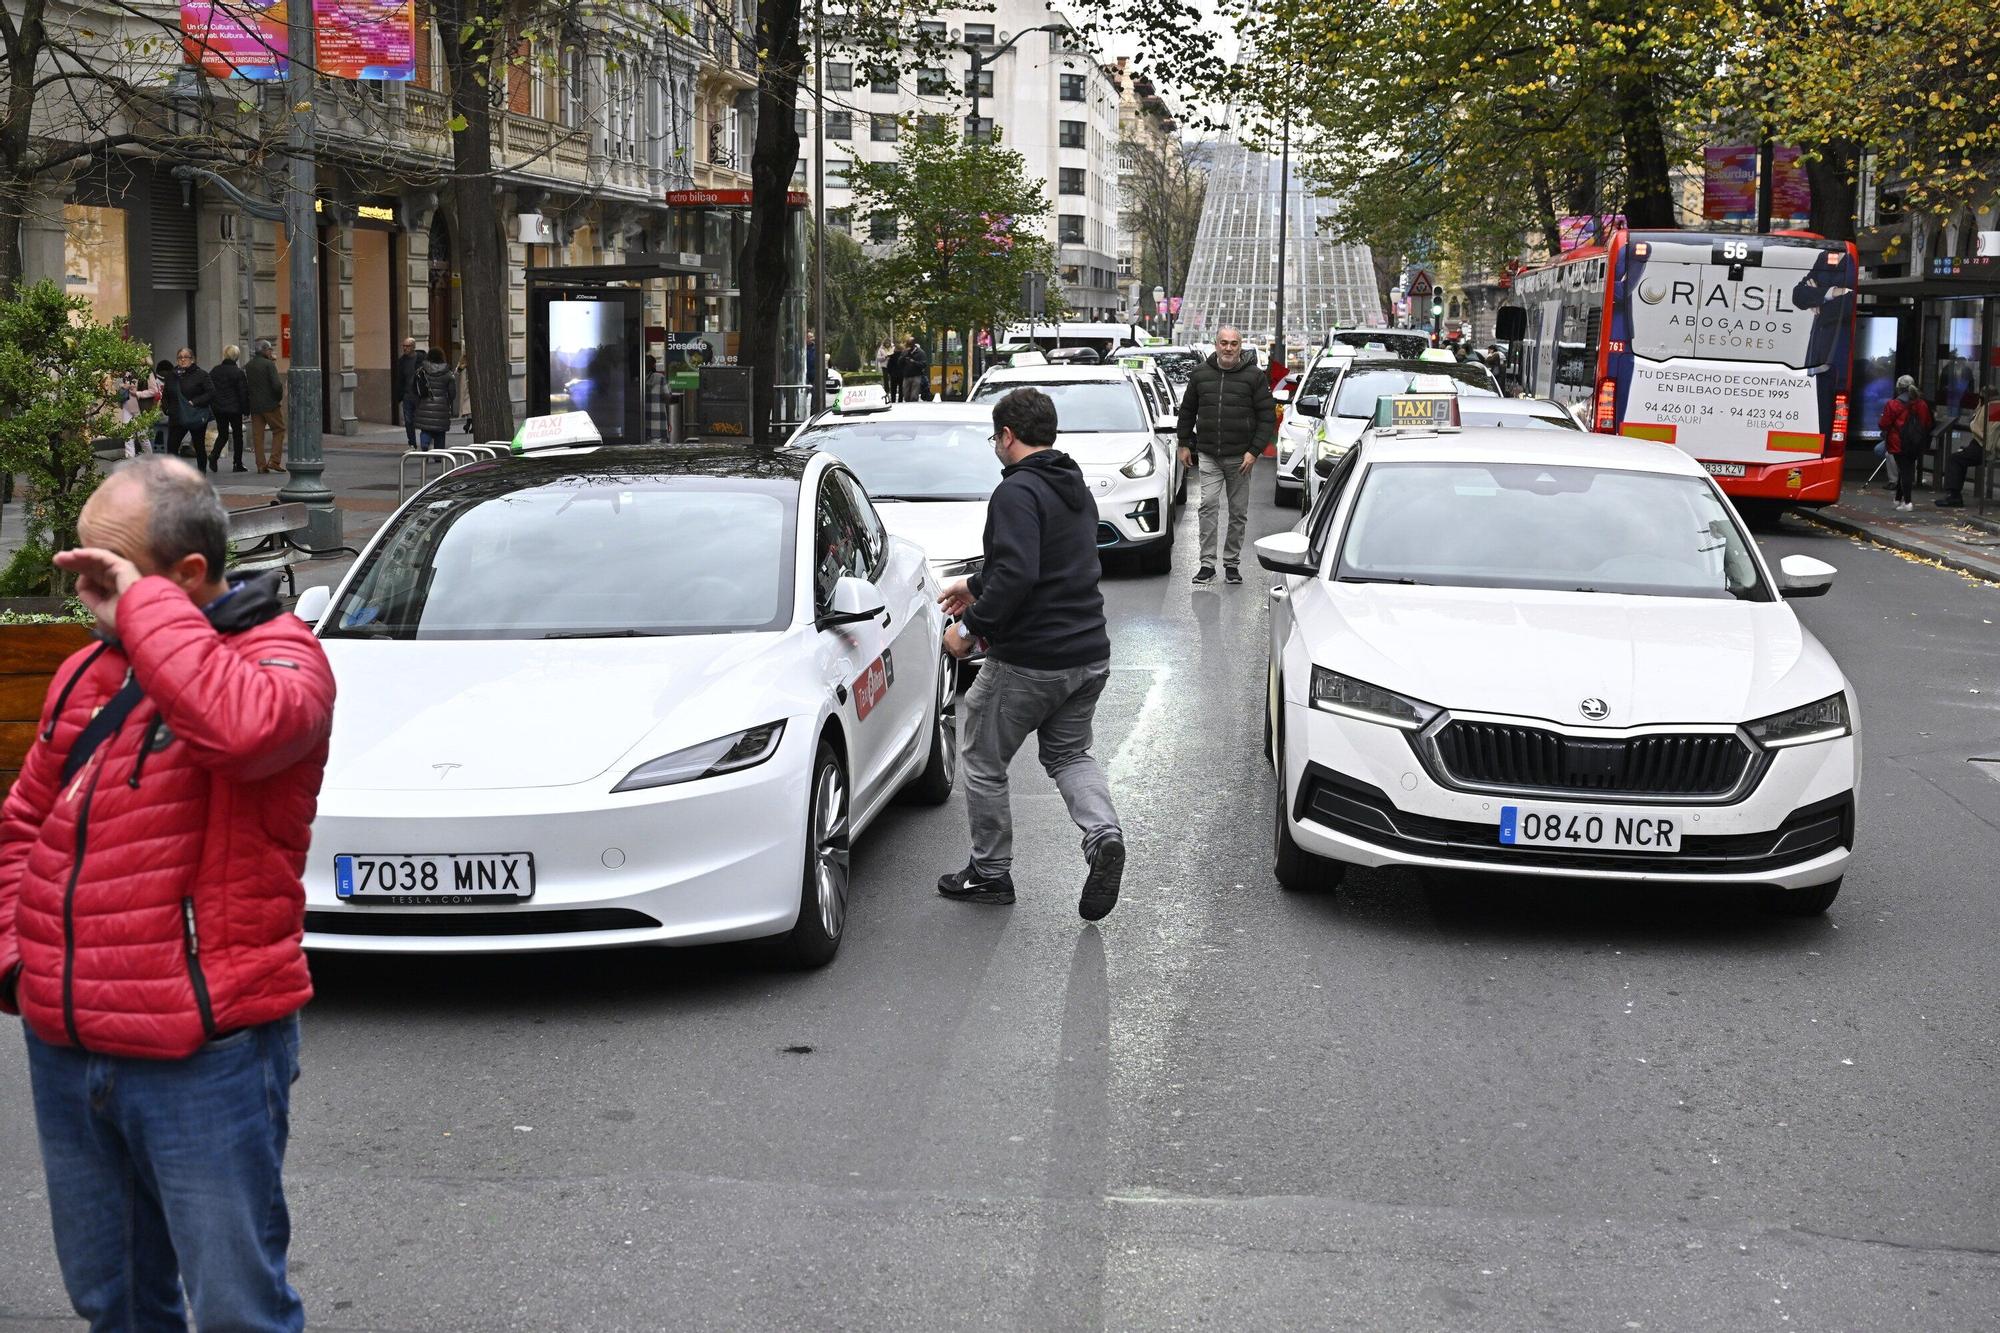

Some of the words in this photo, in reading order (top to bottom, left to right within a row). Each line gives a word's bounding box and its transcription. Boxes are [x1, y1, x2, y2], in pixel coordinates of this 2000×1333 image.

[1706, 168, 1755, 181] Saturday
[1723, 241, 1748, 260] 56
[1669, 314, 1792, 334] ABOGADOS
[1609, 341, 1623, 352] 761
[1683, 334, 1775, 350] ASESORES
[714, 355, 726, 363] ya
[727, 355, 738, 363] es
[1637, 369, 1652, 379] TU
[1656, 371, 1722, 384] DESPACHO
[1724, 375, 1741, 385] DE
[1743, 376, 1812, 389] CONFIANZA
[848, 390, 867, 398] TAXI
[1658, 383, 1674, 393] EN
[1677, 385, 1722, 396] BILBAO
[1724, 388, 1764, 398] DESDE
[1768, 390, 1790, 400] 1995
[1394, 400, 1432, 417] TAXI
[1644, 402, 1658, 412] 94
[1661, 403, 1681, 414] 426
[1684, 404, 1696, 414] 01
[1700, 405, 1714, 416] 34
[1730, 407, 1744, 417] 94
[1746, 408, 1766, 419] 423
[1769, 409, 1783, 420] 94
[1785, 410, 1799, 421] 68
[530, 416, 563, 430] TAXI
[1656, 413, 1702, 425] BASAURI
[1746, 419, 1785, 430] BILBAO
[1725, 464, 1743, 475] KZV
[1504, 828, 1511, 837] E
[1523, 813, 1604, 843] 0840
[1615, 817, 1674, 847] NCR
[358, 861, 438, 891] 7038
[454, 859, 520, 890] MNX
[342, 880, 349, 889] E
[391, 895, 473, 904] TESLA.COM
